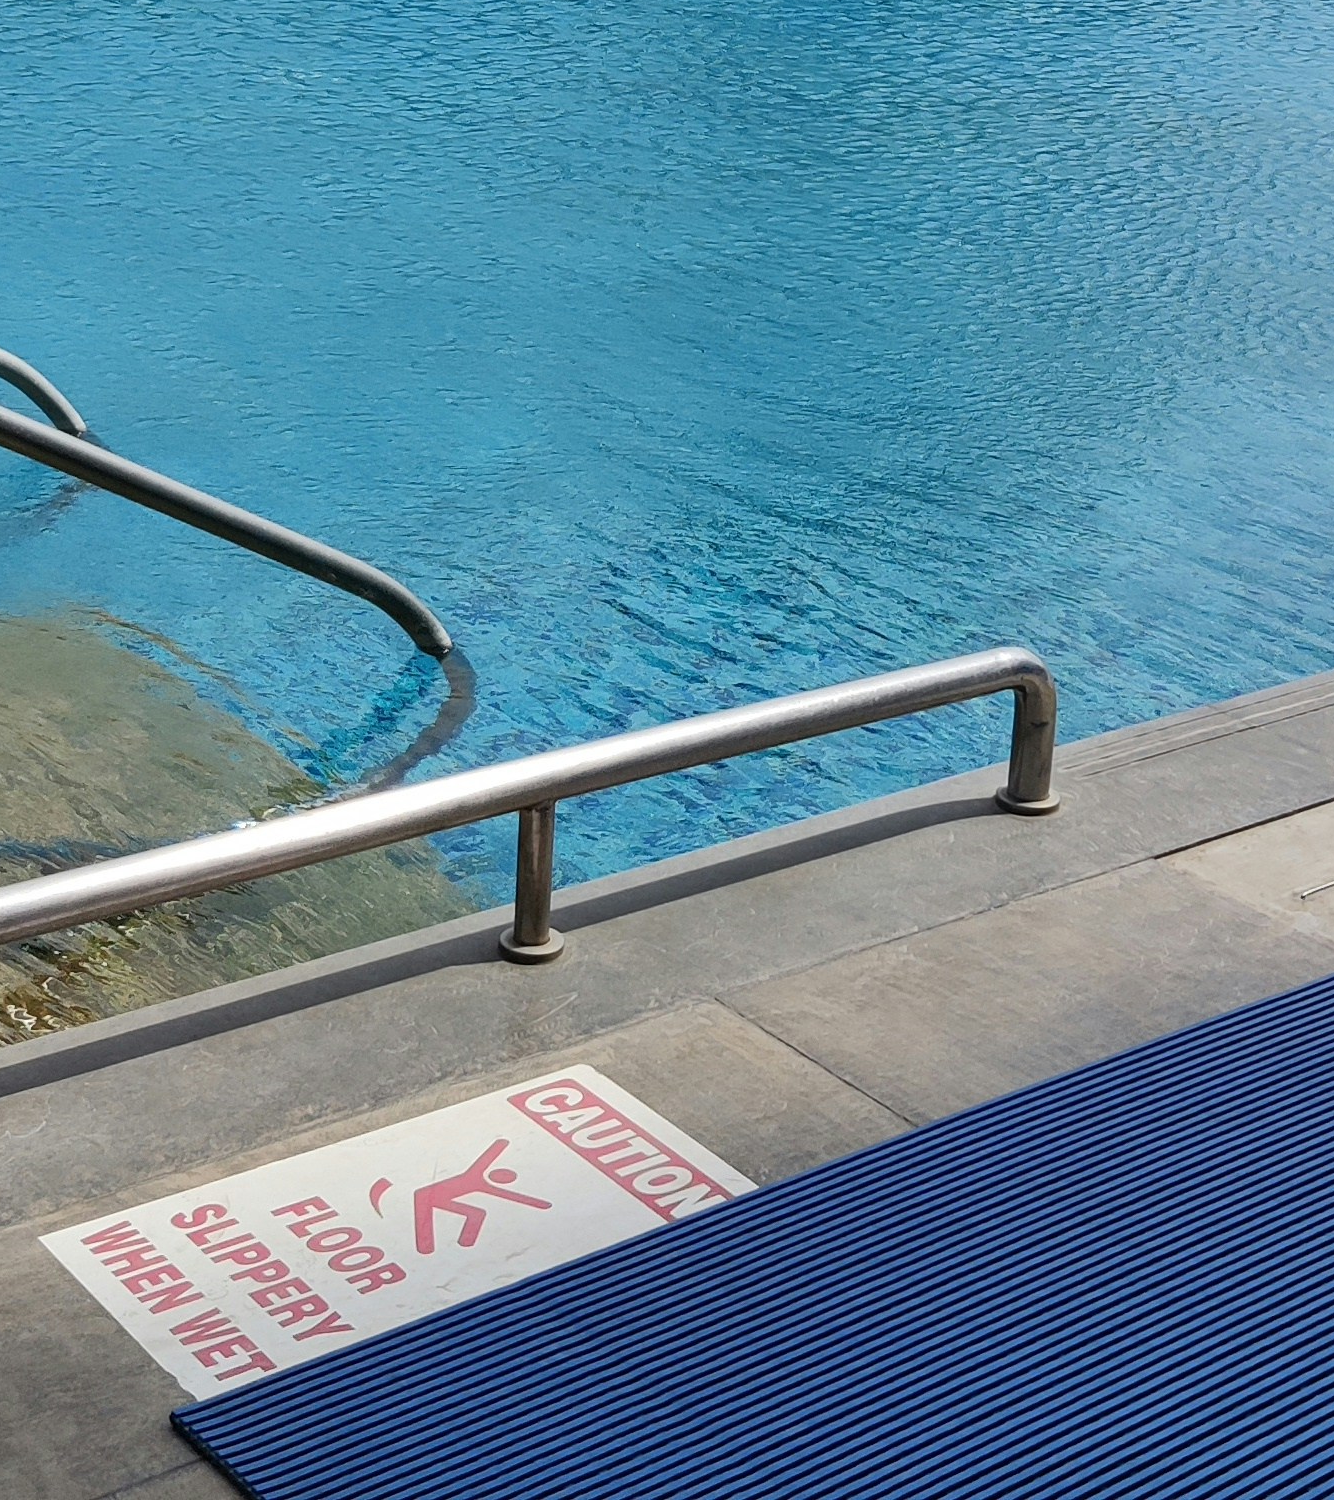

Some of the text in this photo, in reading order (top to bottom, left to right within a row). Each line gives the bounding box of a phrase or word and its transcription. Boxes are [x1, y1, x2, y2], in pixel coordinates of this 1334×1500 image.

[525, 1087, 727, 1219] CAUTION
[80, 1221, 278, 1381] WHEN WET
[171, 1203, 355, 1342] SLIPPERY
[271, 1196, 407, 1295] FLOOR
